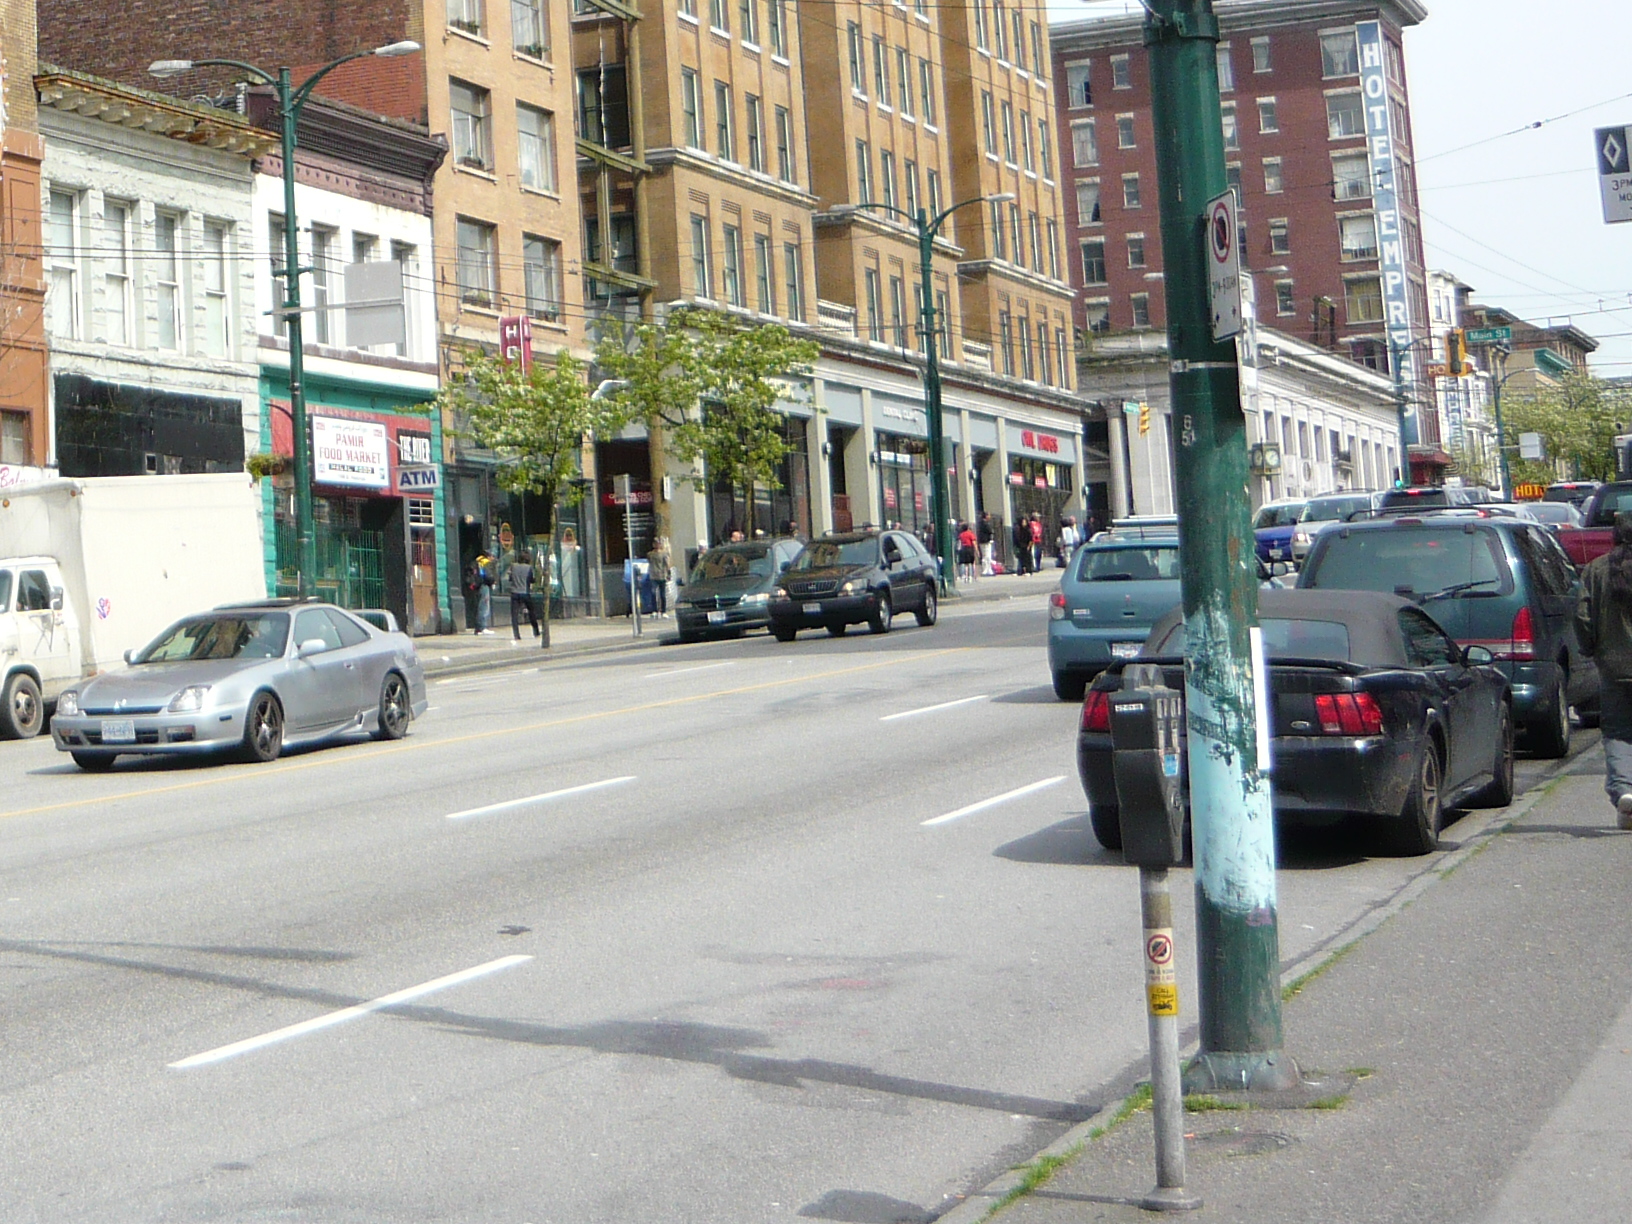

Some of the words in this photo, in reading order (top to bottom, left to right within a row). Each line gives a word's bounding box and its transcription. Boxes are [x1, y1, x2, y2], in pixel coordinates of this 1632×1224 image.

[1362, 42, 1392, 190] HOTEL
[1470, 332, 1492, 340] Main
[1495, 329, 1506, 338] St
[336, 433, 364, 448] PAMIR
[319, 447, 342, 461] FOOD
[346, 450, 381, 464] MARKET
[400, 470, 437, 486] ATM
[1516, 484, 1544, 497] HOT
